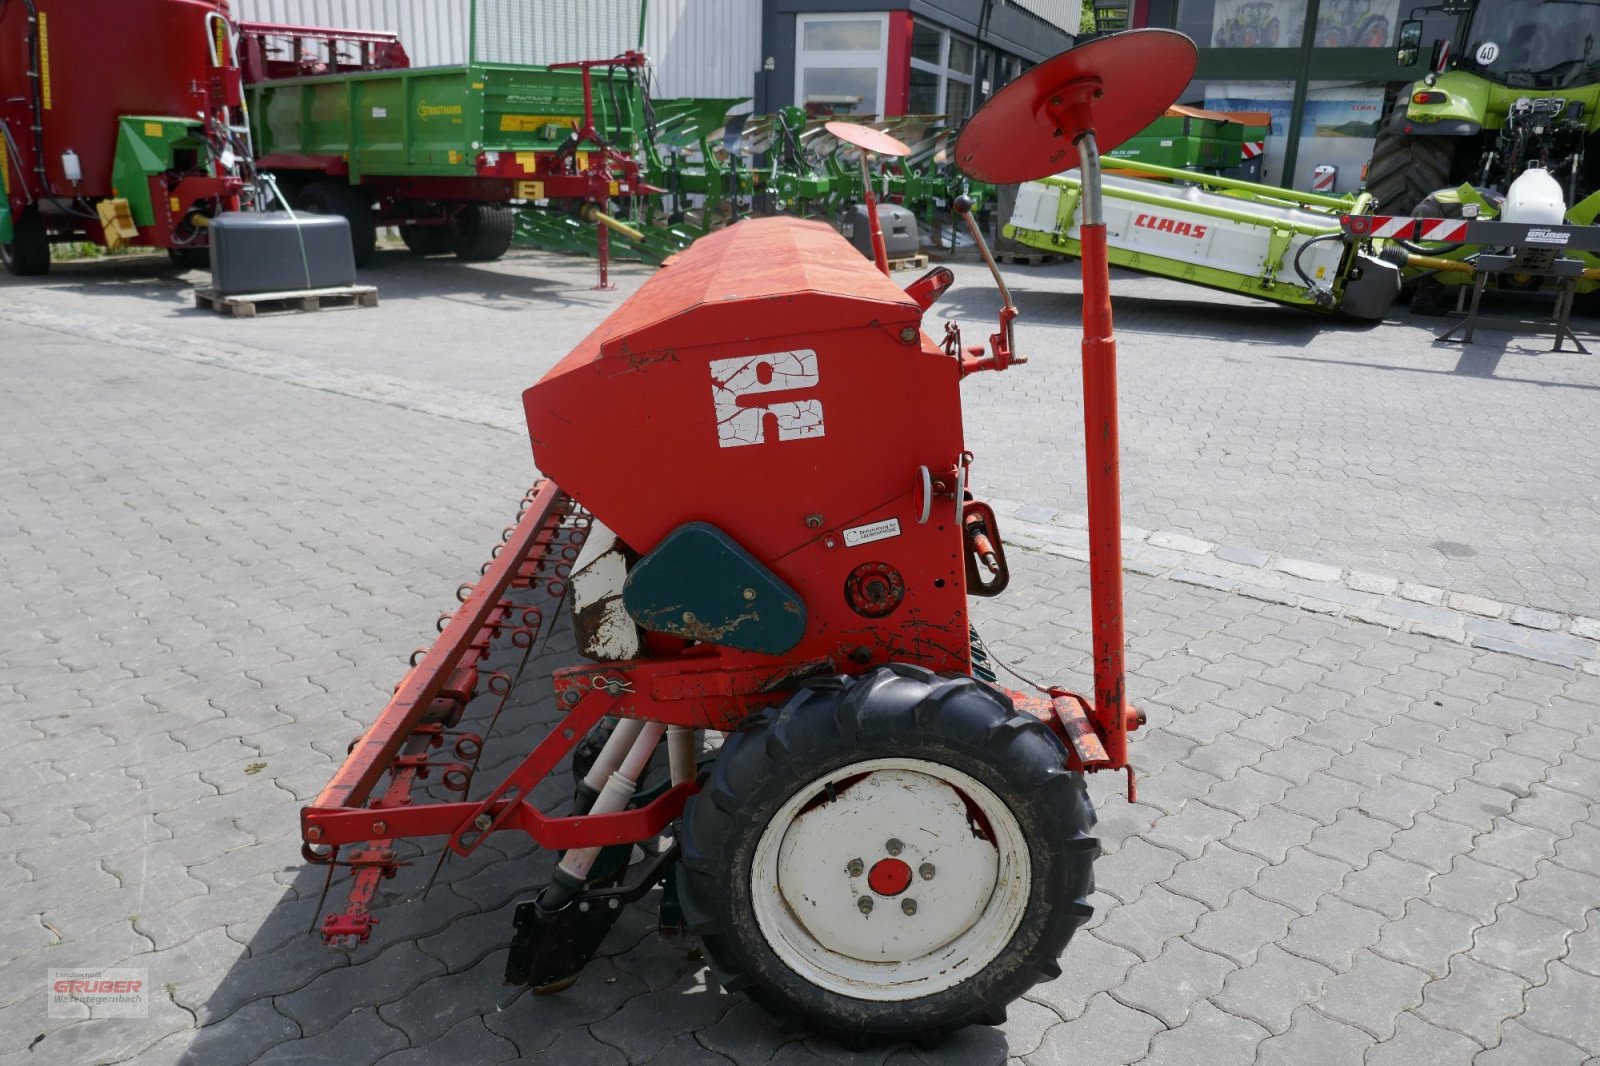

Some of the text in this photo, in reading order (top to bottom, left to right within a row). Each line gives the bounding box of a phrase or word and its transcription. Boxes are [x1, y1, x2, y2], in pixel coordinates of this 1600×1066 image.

[1479, 46, 1495, 60] 40
[421, 105, 462, 116] STRAUTMANN
[1134, 213, 1208, 239] CLAAS
[1527, 231, 1571, 240] GRUBER
